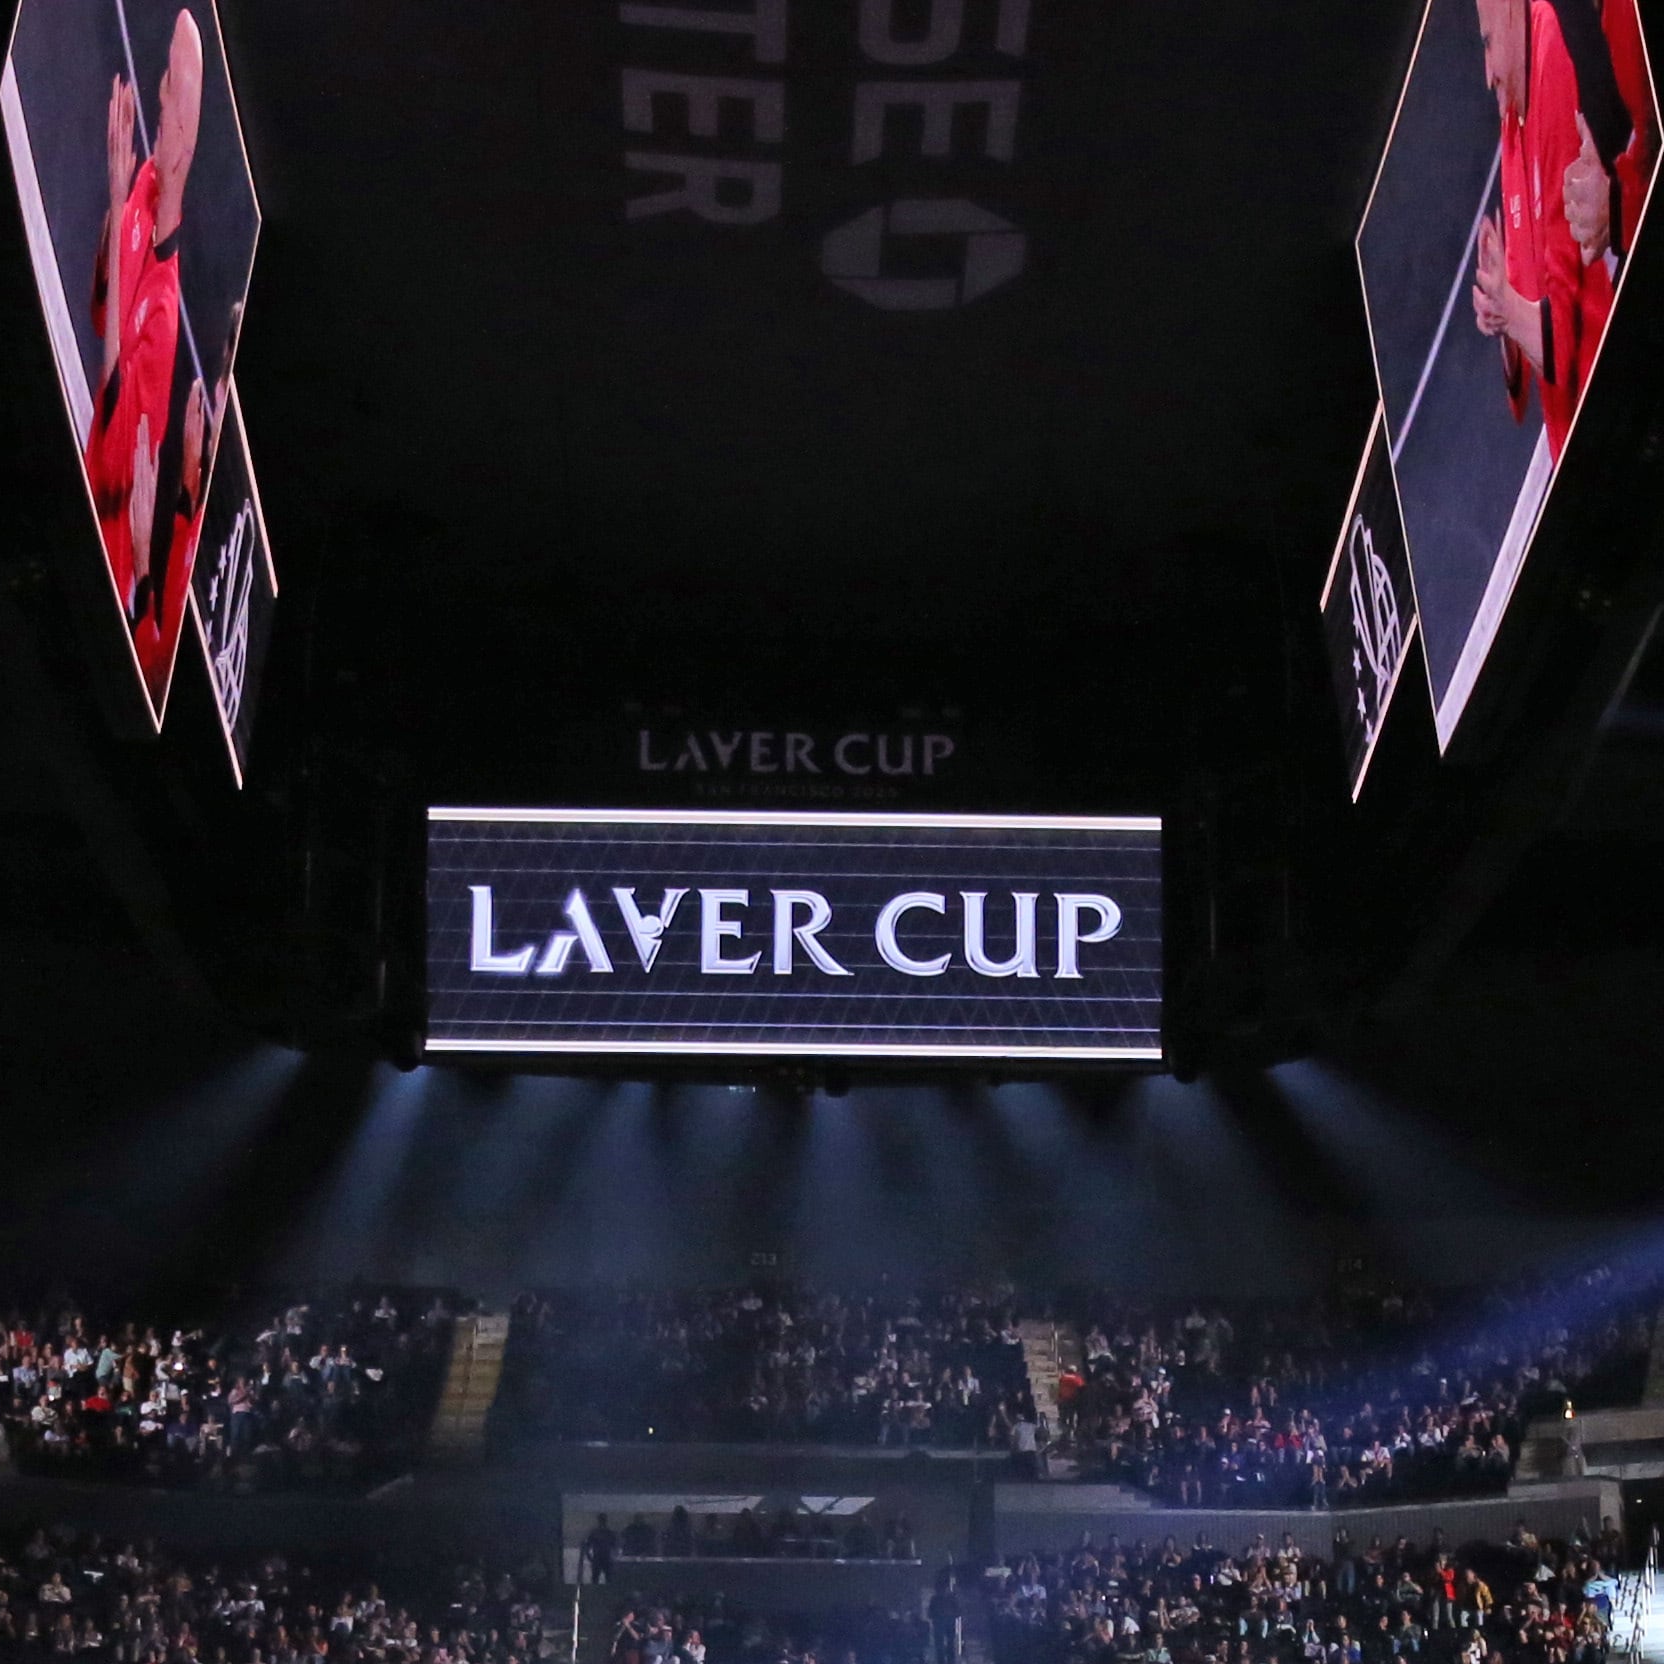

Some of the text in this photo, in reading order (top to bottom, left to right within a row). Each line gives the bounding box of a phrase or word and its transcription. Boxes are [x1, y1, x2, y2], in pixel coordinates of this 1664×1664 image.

[638, 728, 957, 776] LAVER CUP
[468, 885, 1123, 980] LAVER CUP
